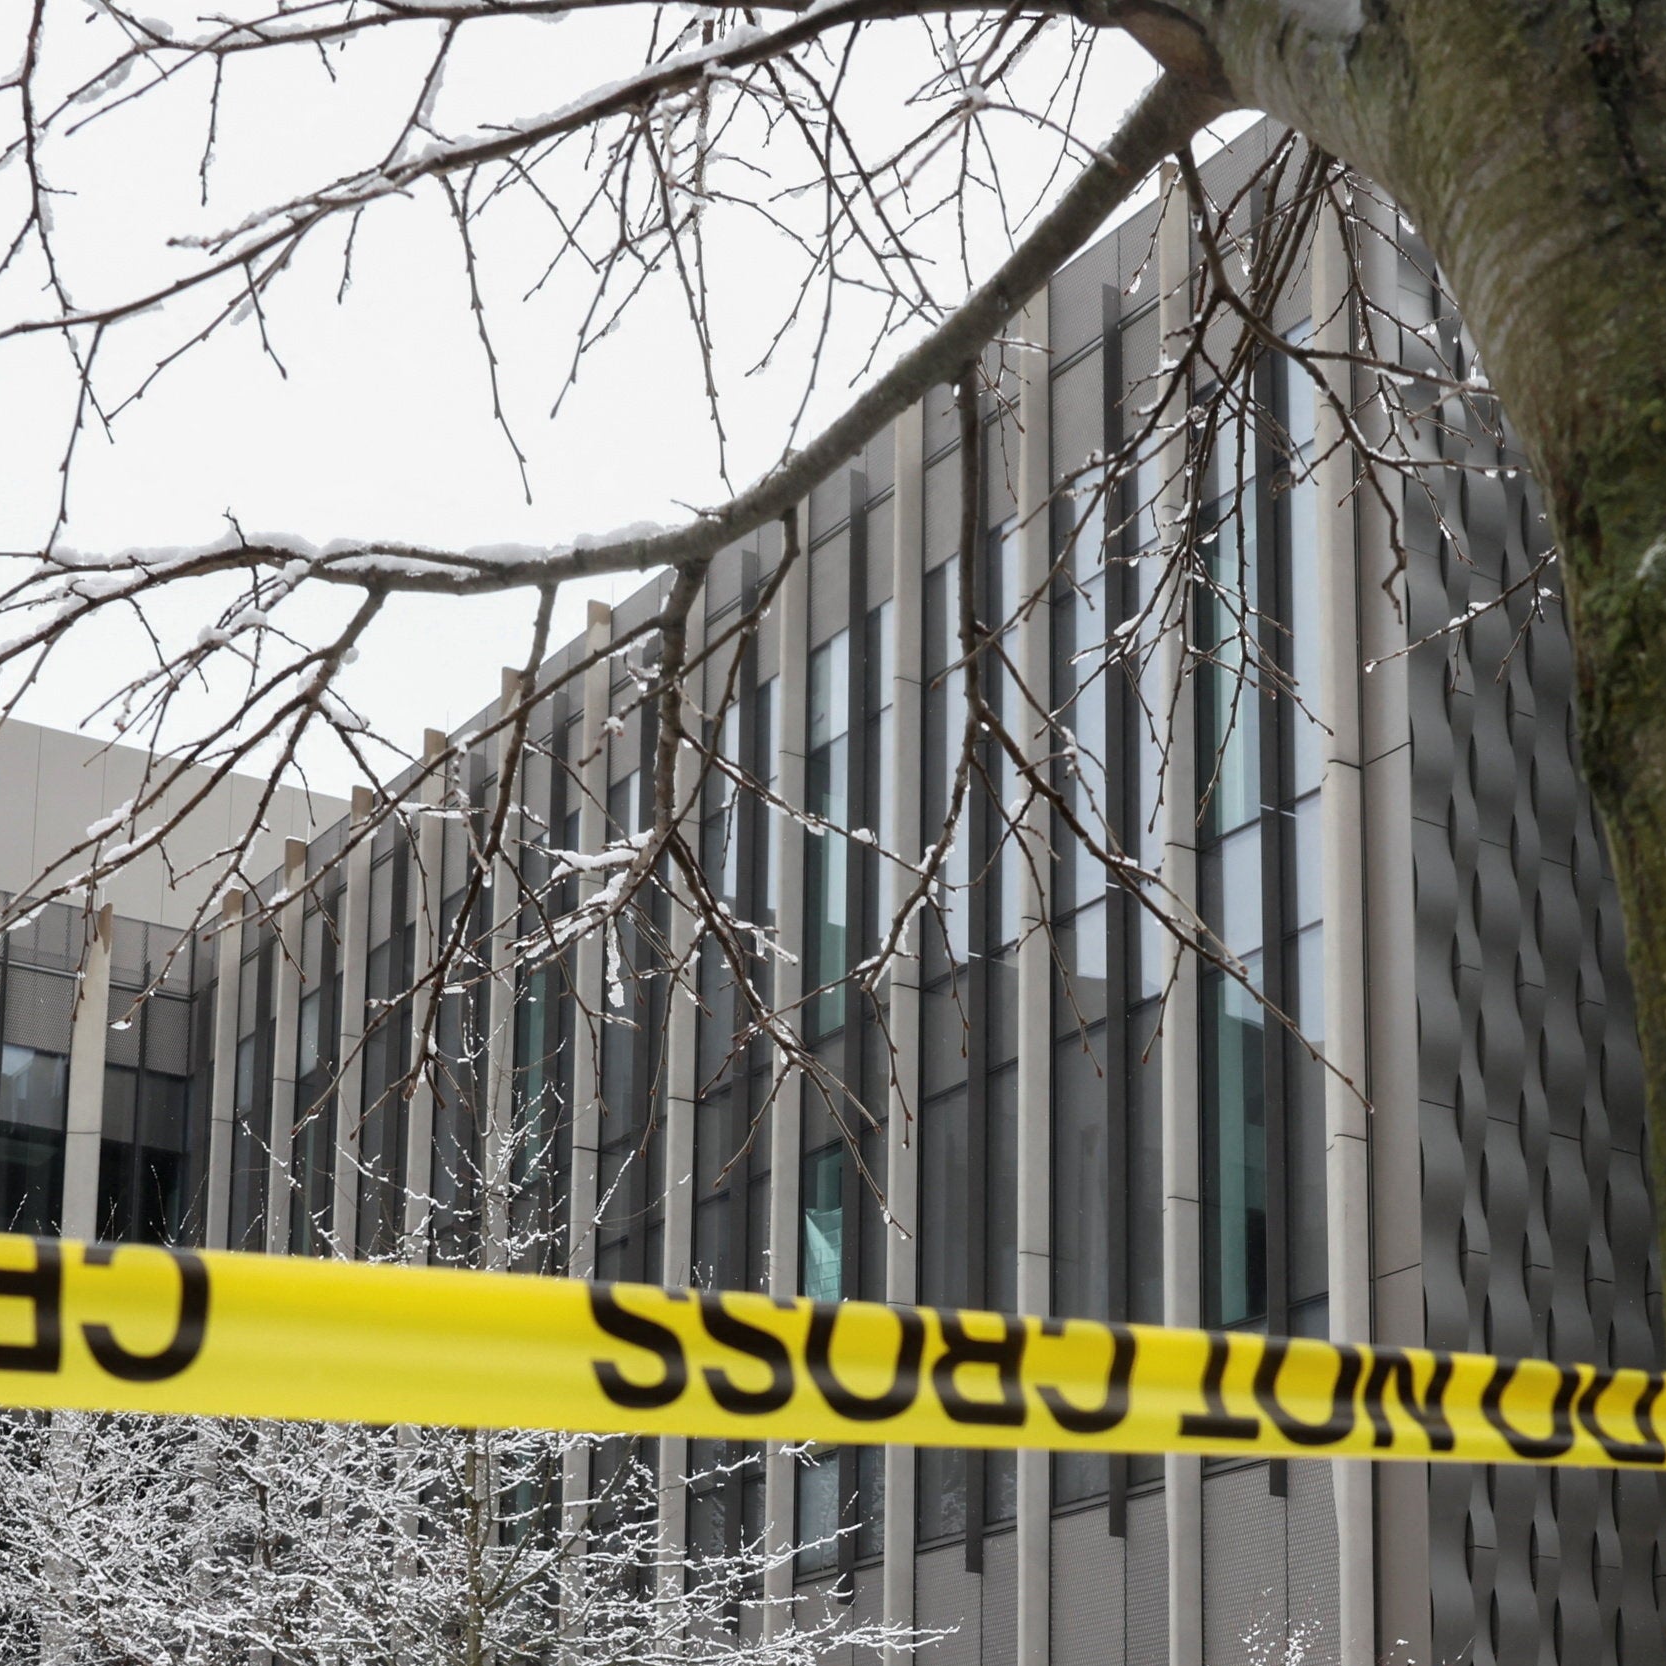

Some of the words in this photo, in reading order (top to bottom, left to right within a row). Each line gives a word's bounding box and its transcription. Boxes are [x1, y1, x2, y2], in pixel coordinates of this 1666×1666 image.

[589, 1281, 1137, 1434] CROSS
[1179, 1332, 1454, 1450] NOT
[1480, 1354, 1666, 1463] DO
